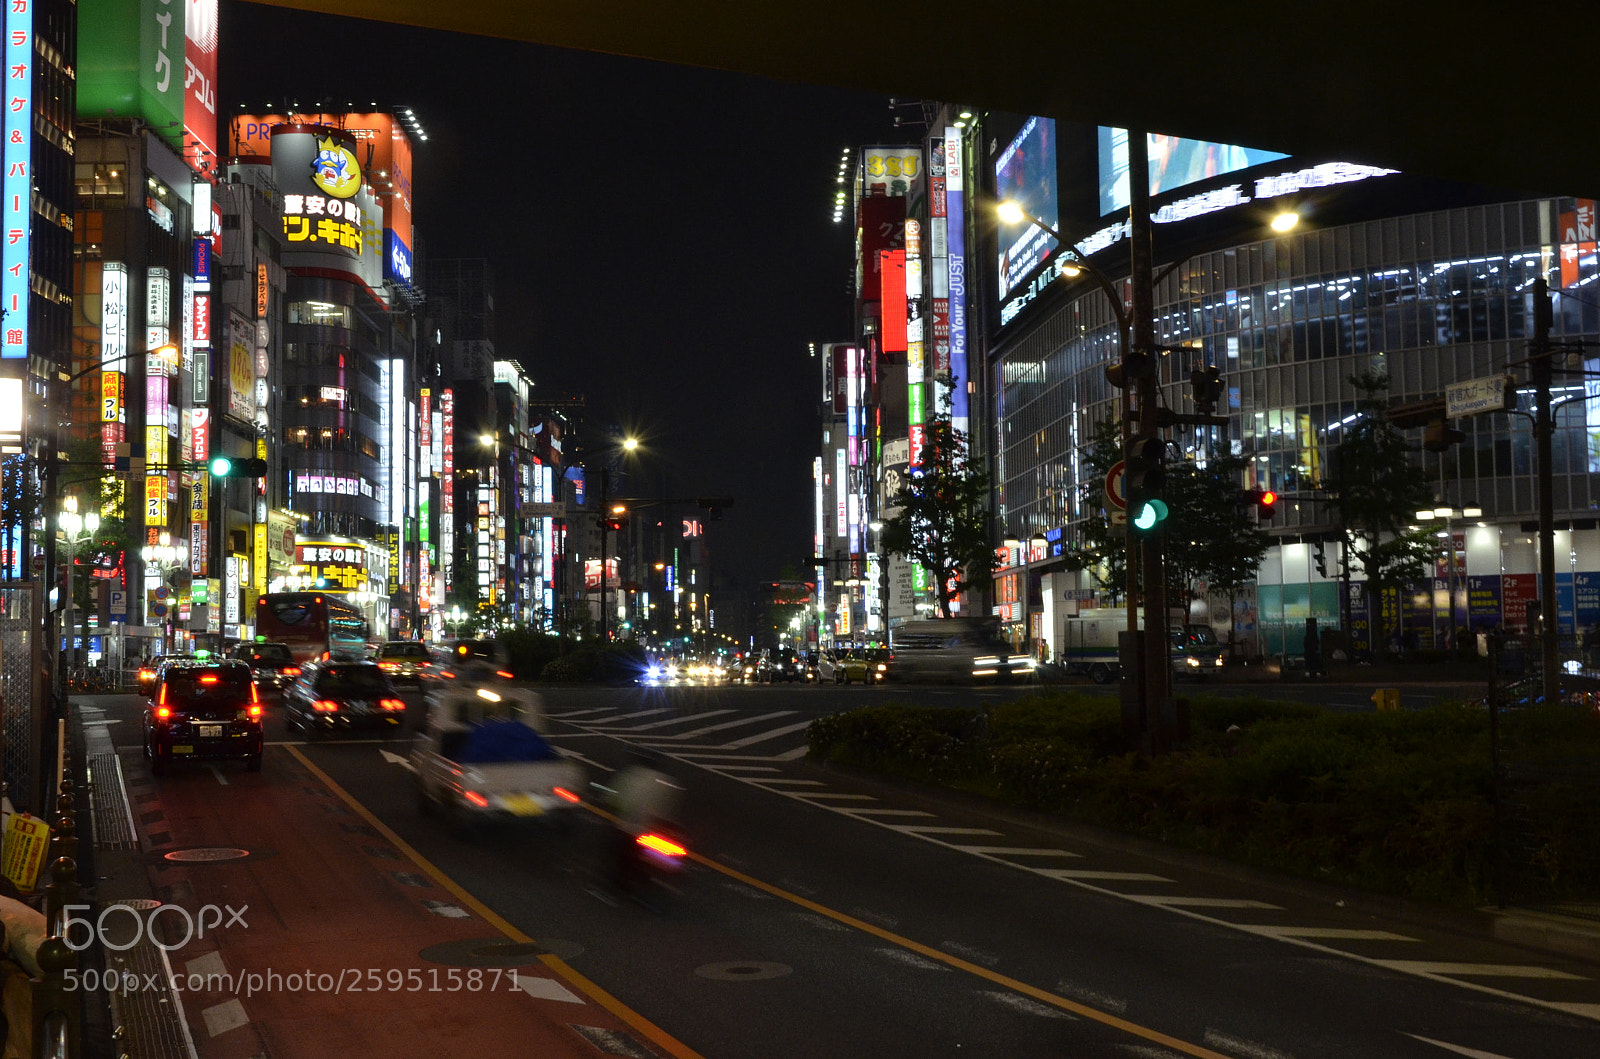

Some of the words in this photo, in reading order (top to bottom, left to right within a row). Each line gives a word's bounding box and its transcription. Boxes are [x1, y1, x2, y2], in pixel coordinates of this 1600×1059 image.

[155, 0, 172, 93] イク
[185, 57, 215, 115] アコム
[948, 141, 956, 165] LABI
[7, 0, 27, 345] カラオケ&パーティー館
[197, 243, 206, 274] PROMISE
[949, 253, 965, 296] JUST
[104, 280, 119, 356] 小松ビル
[195, 304, 207, 340] アイフル
[951, 333, 965, 354] For
[104, 373, 117, 420] 麻雀ブル
[444, 392, 453, 435] カラオケ
[194, 428, 205, 453] アコム
[147, 477, 160, 517] 麻雀ブル
[195, 512, 205, 520] 2F
[916, 564, 925, 588] レイク
[1435, 580, 1448, 590] B1
[1469, 579, 1482, 589] 1F
[1503, 578, 1518, 588] 2F
[1575, 576, 1589, 585] 4F
